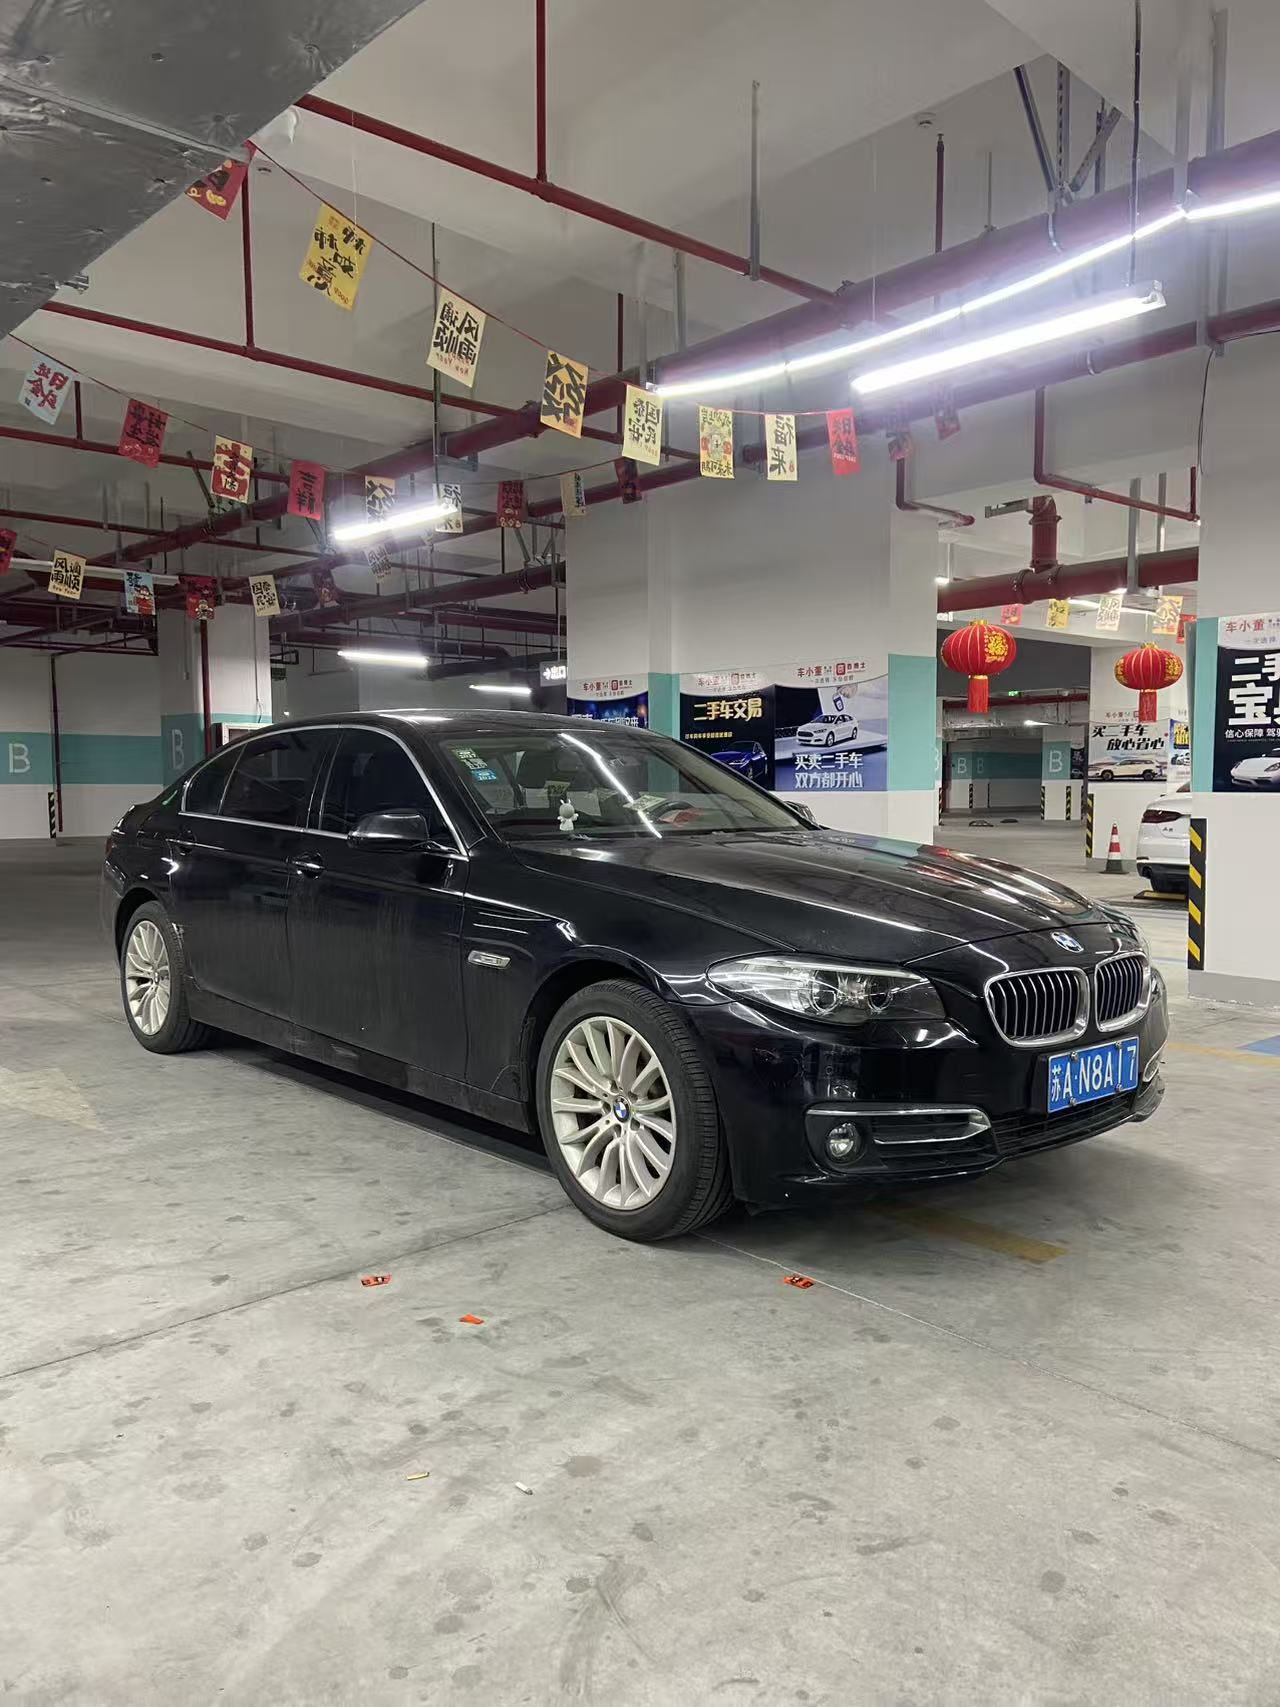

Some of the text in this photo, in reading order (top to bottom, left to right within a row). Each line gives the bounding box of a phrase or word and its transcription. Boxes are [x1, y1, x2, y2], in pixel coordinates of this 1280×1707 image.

[1226, 618, 1265, 632] 车小董
[797, 665, 822, 677] 车小董
[693, 698, 762, 721] 二手车交易
[1092, 724, 1149, 738] 买二手车
[1225, 728, 1263, 739] 信心保障
[172, 729, 185, 769] B
[1106, 737, 1165, 751] 放心省心
[8, 743, 31, 774] B
[795, 752, 864, 770] 买卖二手车
[957, 757, 967, 774] B
[1049, 750, 1063, 772] B
[795, 771, 864, 788] 双方都开心
